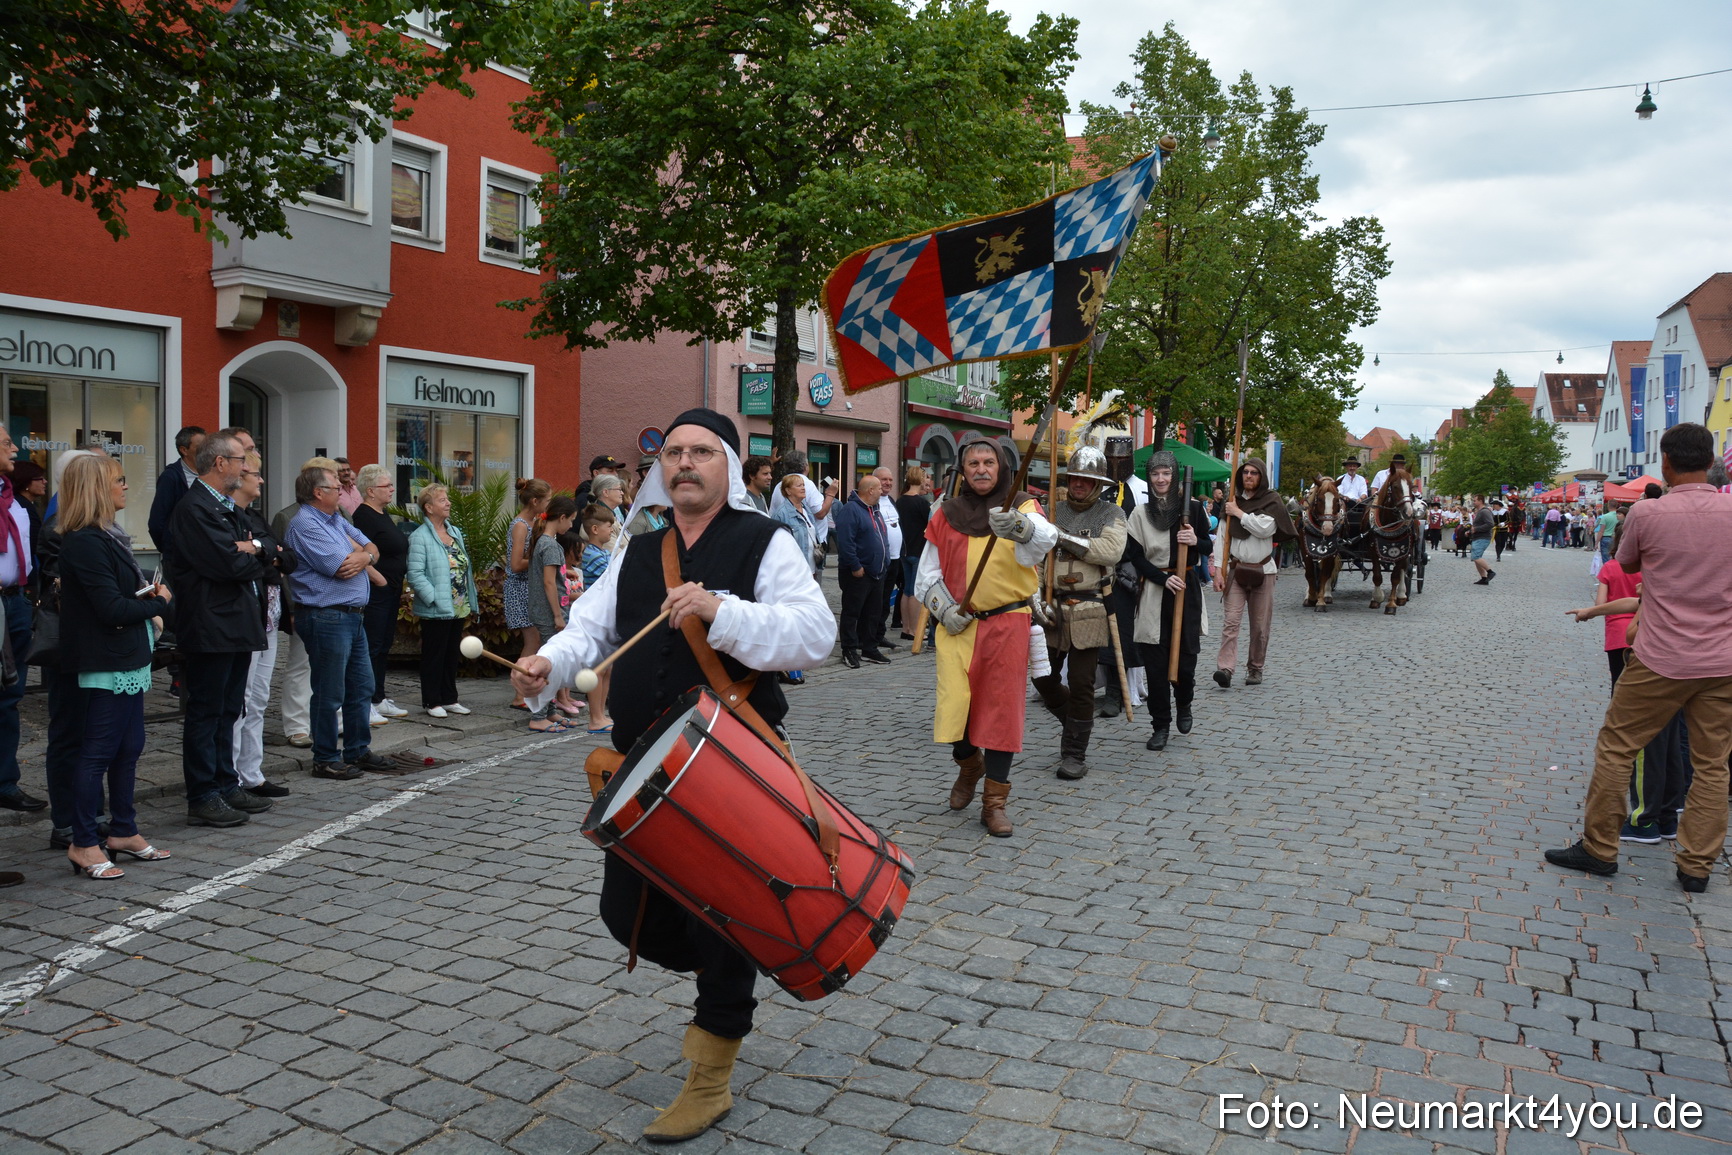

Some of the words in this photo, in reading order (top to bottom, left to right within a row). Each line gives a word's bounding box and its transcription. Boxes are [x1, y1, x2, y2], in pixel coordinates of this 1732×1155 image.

[750, 381, 769, 395] FASS
[809, 376, 823, 389] vom
[813, 384, 833, 403] FASS
